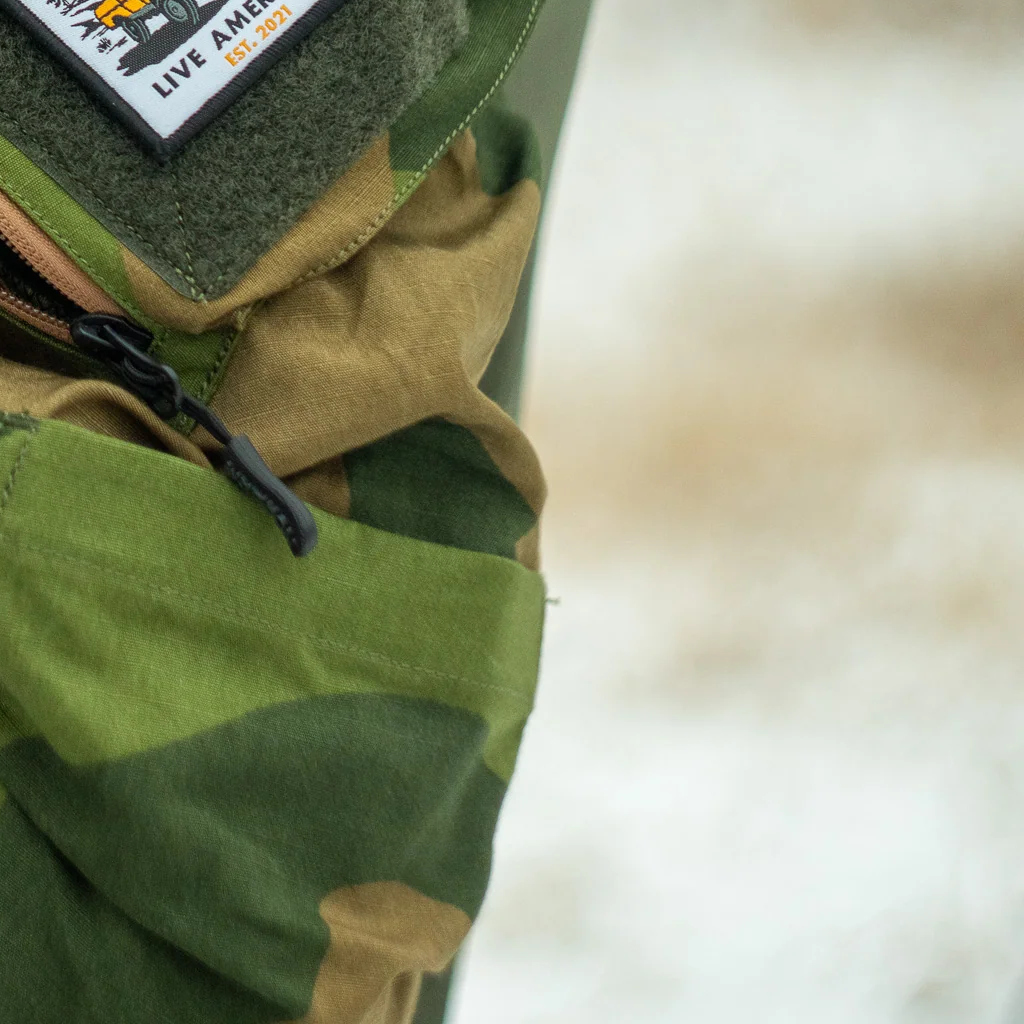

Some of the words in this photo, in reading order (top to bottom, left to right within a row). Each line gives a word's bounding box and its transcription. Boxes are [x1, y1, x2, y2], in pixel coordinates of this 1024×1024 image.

[224, 38, 257, 67] EST.
[255, 4, 293, 39] 2021
[152, 48, 206, 98] LIVE
